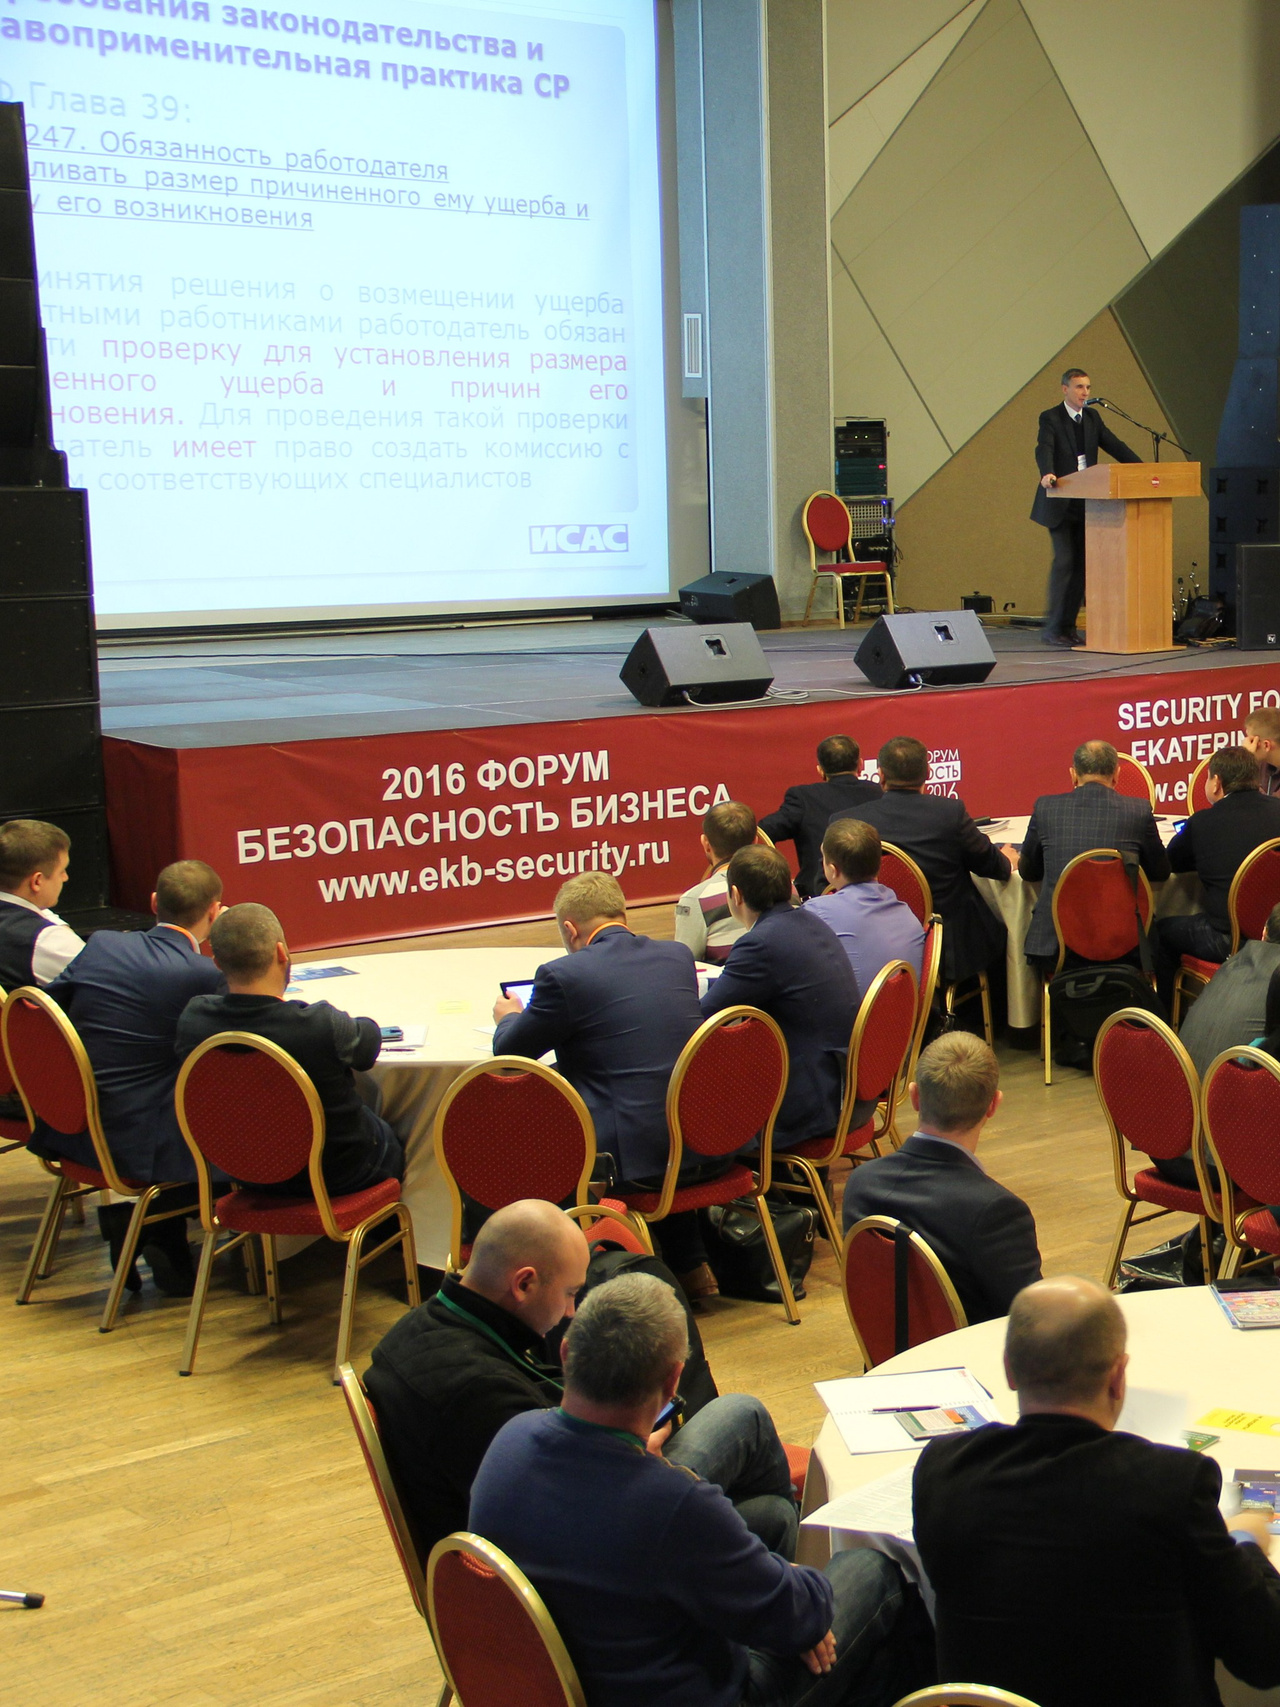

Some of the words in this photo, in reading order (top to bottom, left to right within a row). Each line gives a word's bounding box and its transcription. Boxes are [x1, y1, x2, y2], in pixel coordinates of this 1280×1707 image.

[6, 0, 210, 22] вания
[221, 4, 517, 60] законодательства
[527, 41, 544, 61] и
[0, 16, 371, 80] авоприменительная
[381, 61, 523, 95] практика
[534, 73, 570, 98] СР
[28, 81, 127, 117] Глава
[141, 92, 191, 123] 39:
[100, 130, 272, 165] Обязанность
[286, 149, 448, 180] работодателя
[57, 195, 101, 214] его
[115, 198, 313, 228] возникновения
[145, 168, 239, 197] размер
[250, 177, 421, 206] причиненного
[434, 192, 474, 214] ему
[484, 194, 566, 219] ущерба
[577, 202, 589, 218] и
[171, 275, 296, 300] решения
[319, 283, 334, 301] о
[358, 284, 515, 310] возмещении
[535, 292, 625, 315] ущерба
[43, 304, 140, 326] тными
[160, 304, 343, 333] работниками
[359, 313, 530, 340] работодатель
[544, 319, 626, 343] обязан
[102, 338, 242, 366] проверку
[263, 344, 312, 367] для
[333, 345, 510, 370] установления
[529, 352, 628, 375] размера
[53, 371, 157, 392] енного
[220, 371, 324, 399] ущерба
[382, 379, 396, 397] и
[451, 380, 541, 402] причин
[589, 384, 628, 401] его
[199, 402, 251, 429] Для
[266, 407, 423, 431] проведения
[434, 406, 504, 429] такой
[517, 411, 628, 433] проверки
[172, 440, 257, 459] имеет
[274, 440, 353, 463] право
[371, 440, 468, 461] создать
[485, 441, 603, 459] комиссию
[618, 442, 629, 459] с
[98, 471, 348, 493] соответствующих
[359, 470, 533, 492] специалистов
[531, 524, 628, 553] ИСАС
[1118, 692, 1243, 731] SECURITY
[381, 762, 466, 801] 2016
[476, 750, 610, 791] ФОРУМ
[237, 801, 560, 864] БЕЗОПАСНОСТЬ
[570, 783, 731, 829] БИЗНЕСА
[318, 840, 670, 903] www.ekb-security.ru
